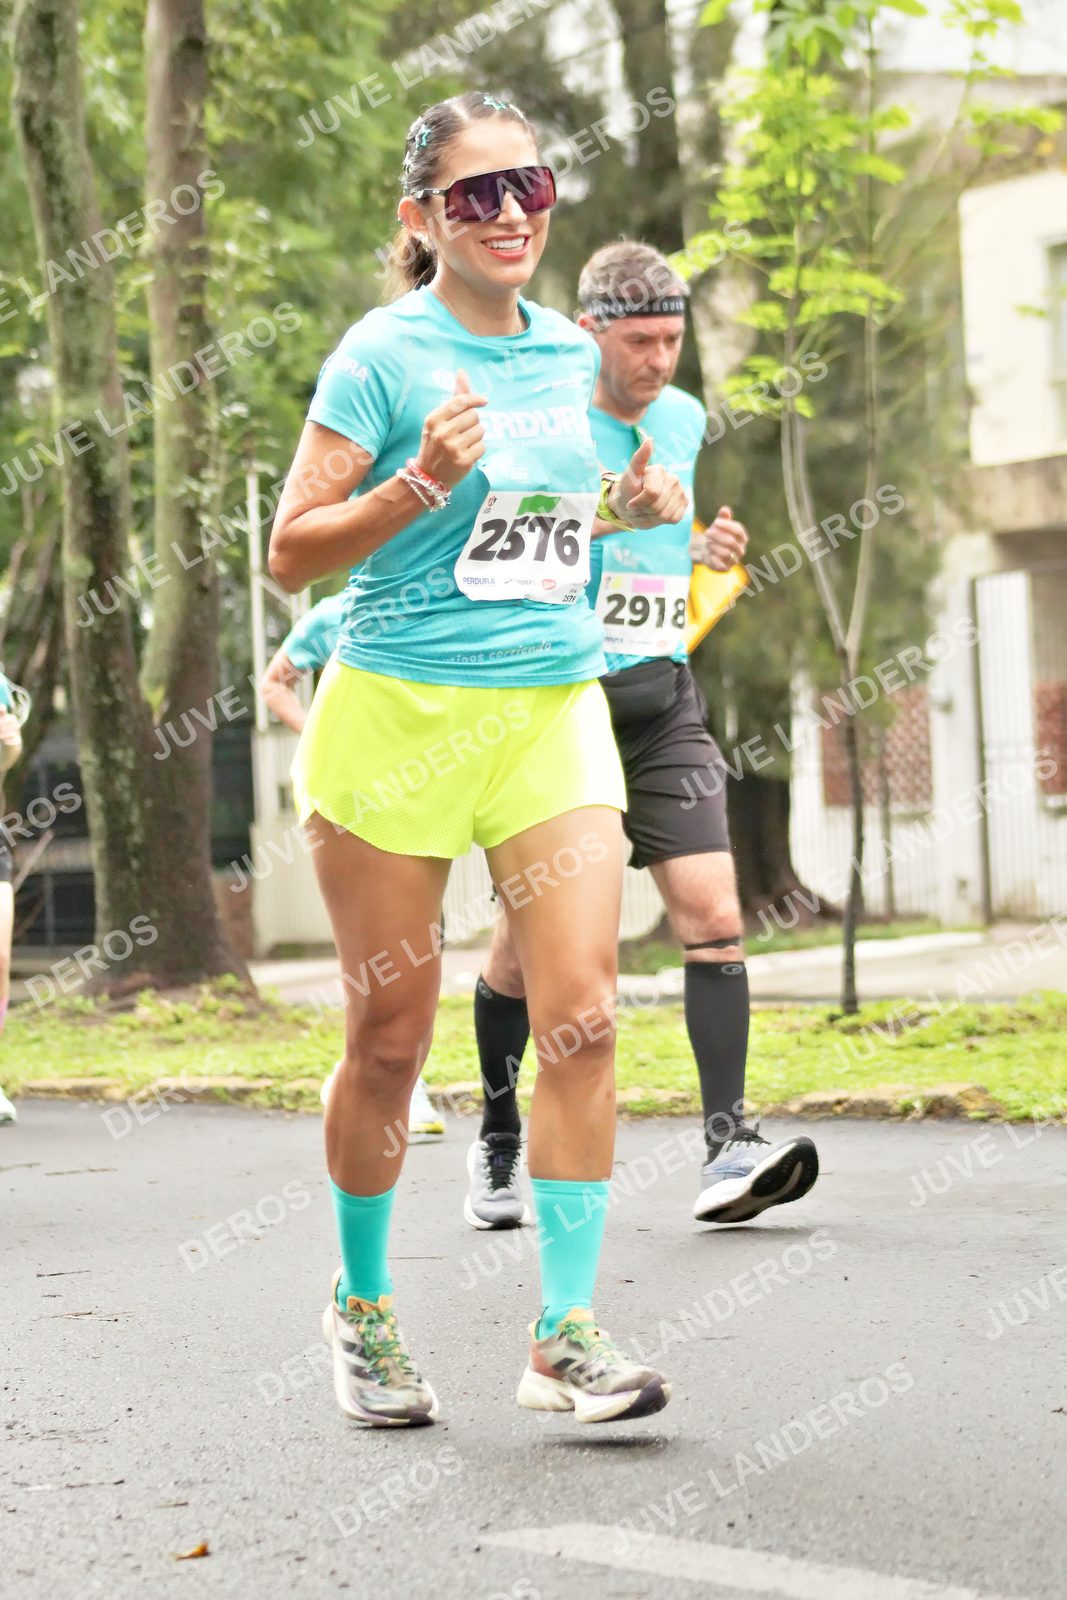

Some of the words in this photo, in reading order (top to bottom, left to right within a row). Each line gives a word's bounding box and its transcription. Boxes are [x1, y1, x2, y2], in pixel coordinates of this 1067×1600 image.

[477, 405, 591, 441] ERDUR
[468, 516, 582, 567] 2576
[603, 593, 686, 629] 2918
